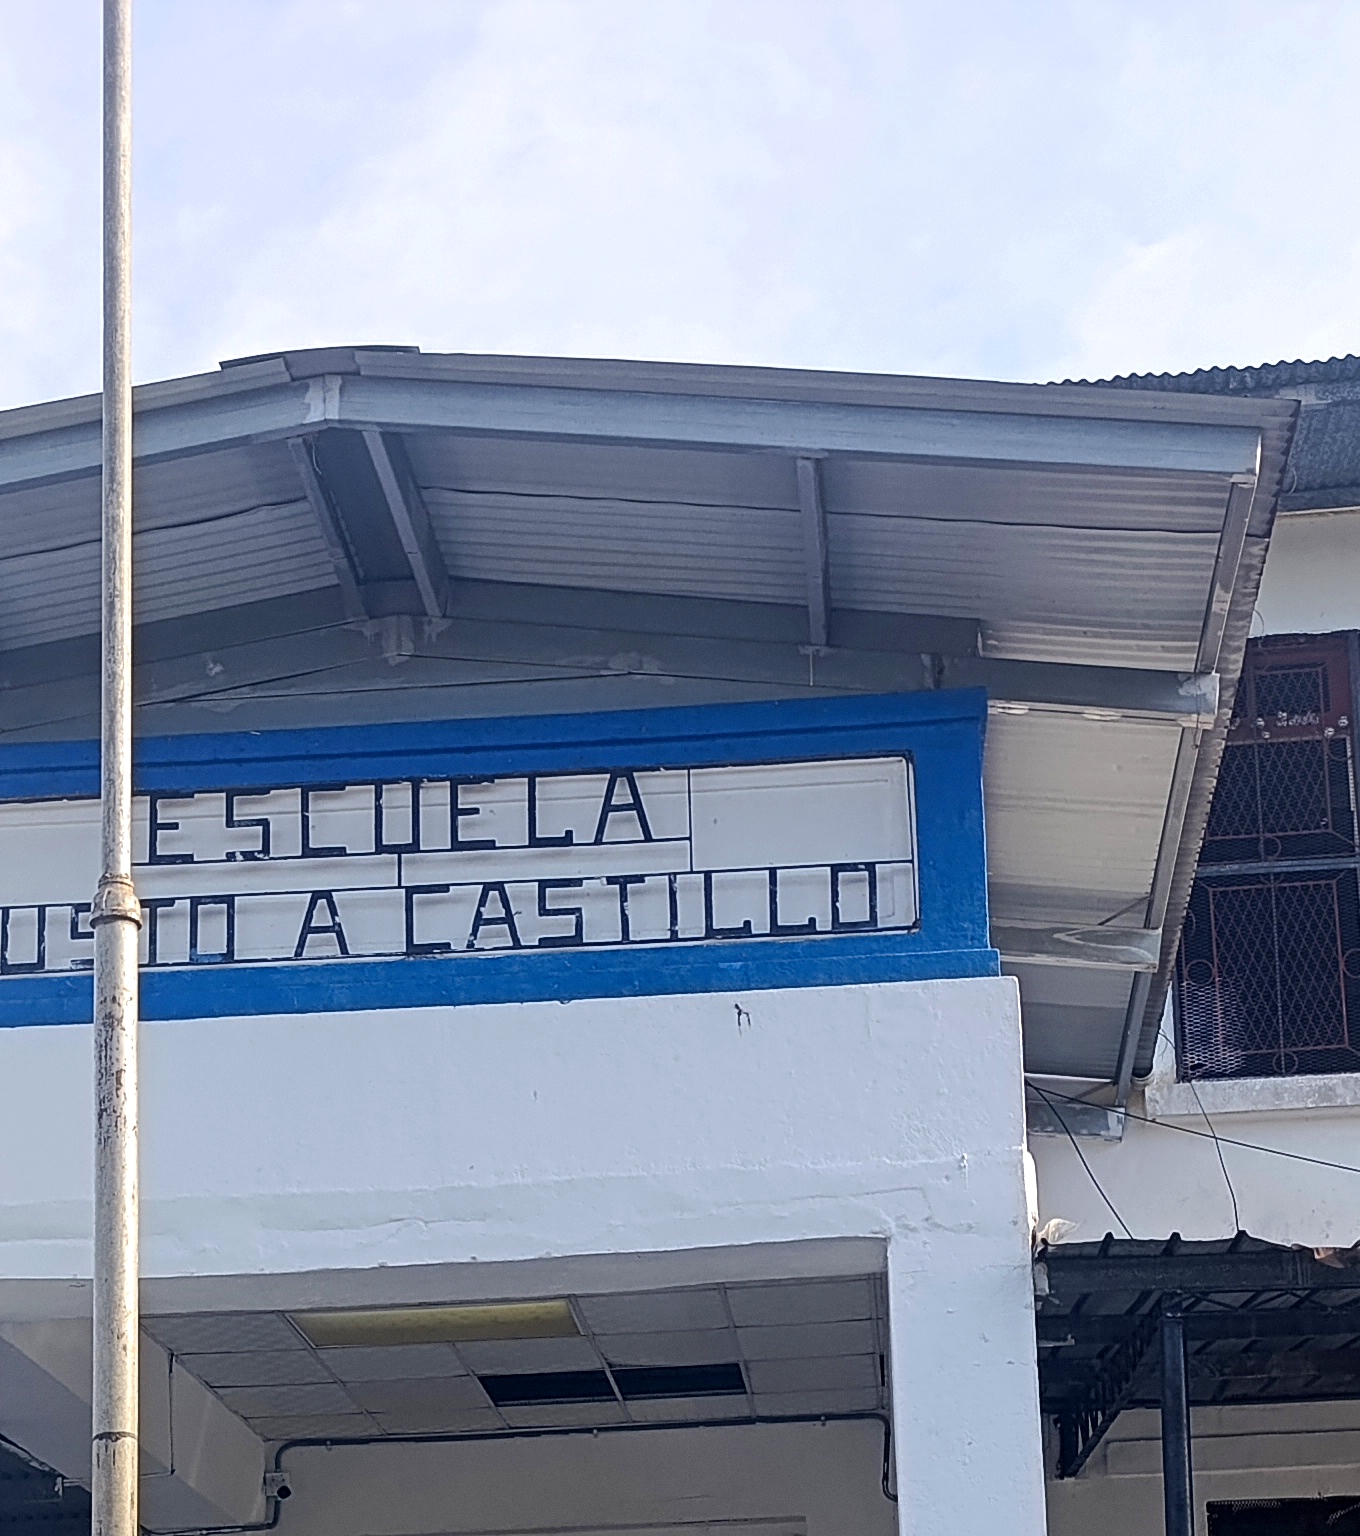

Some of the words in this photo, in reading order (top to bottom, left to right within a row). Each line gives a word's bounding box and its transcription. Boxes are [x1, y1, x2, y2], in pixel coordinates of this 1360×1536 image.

[148, 769, 654, 864] ESCUELA
[293, 889, 351, 959] A
[404, 861, 879, 956] CASTILLO
